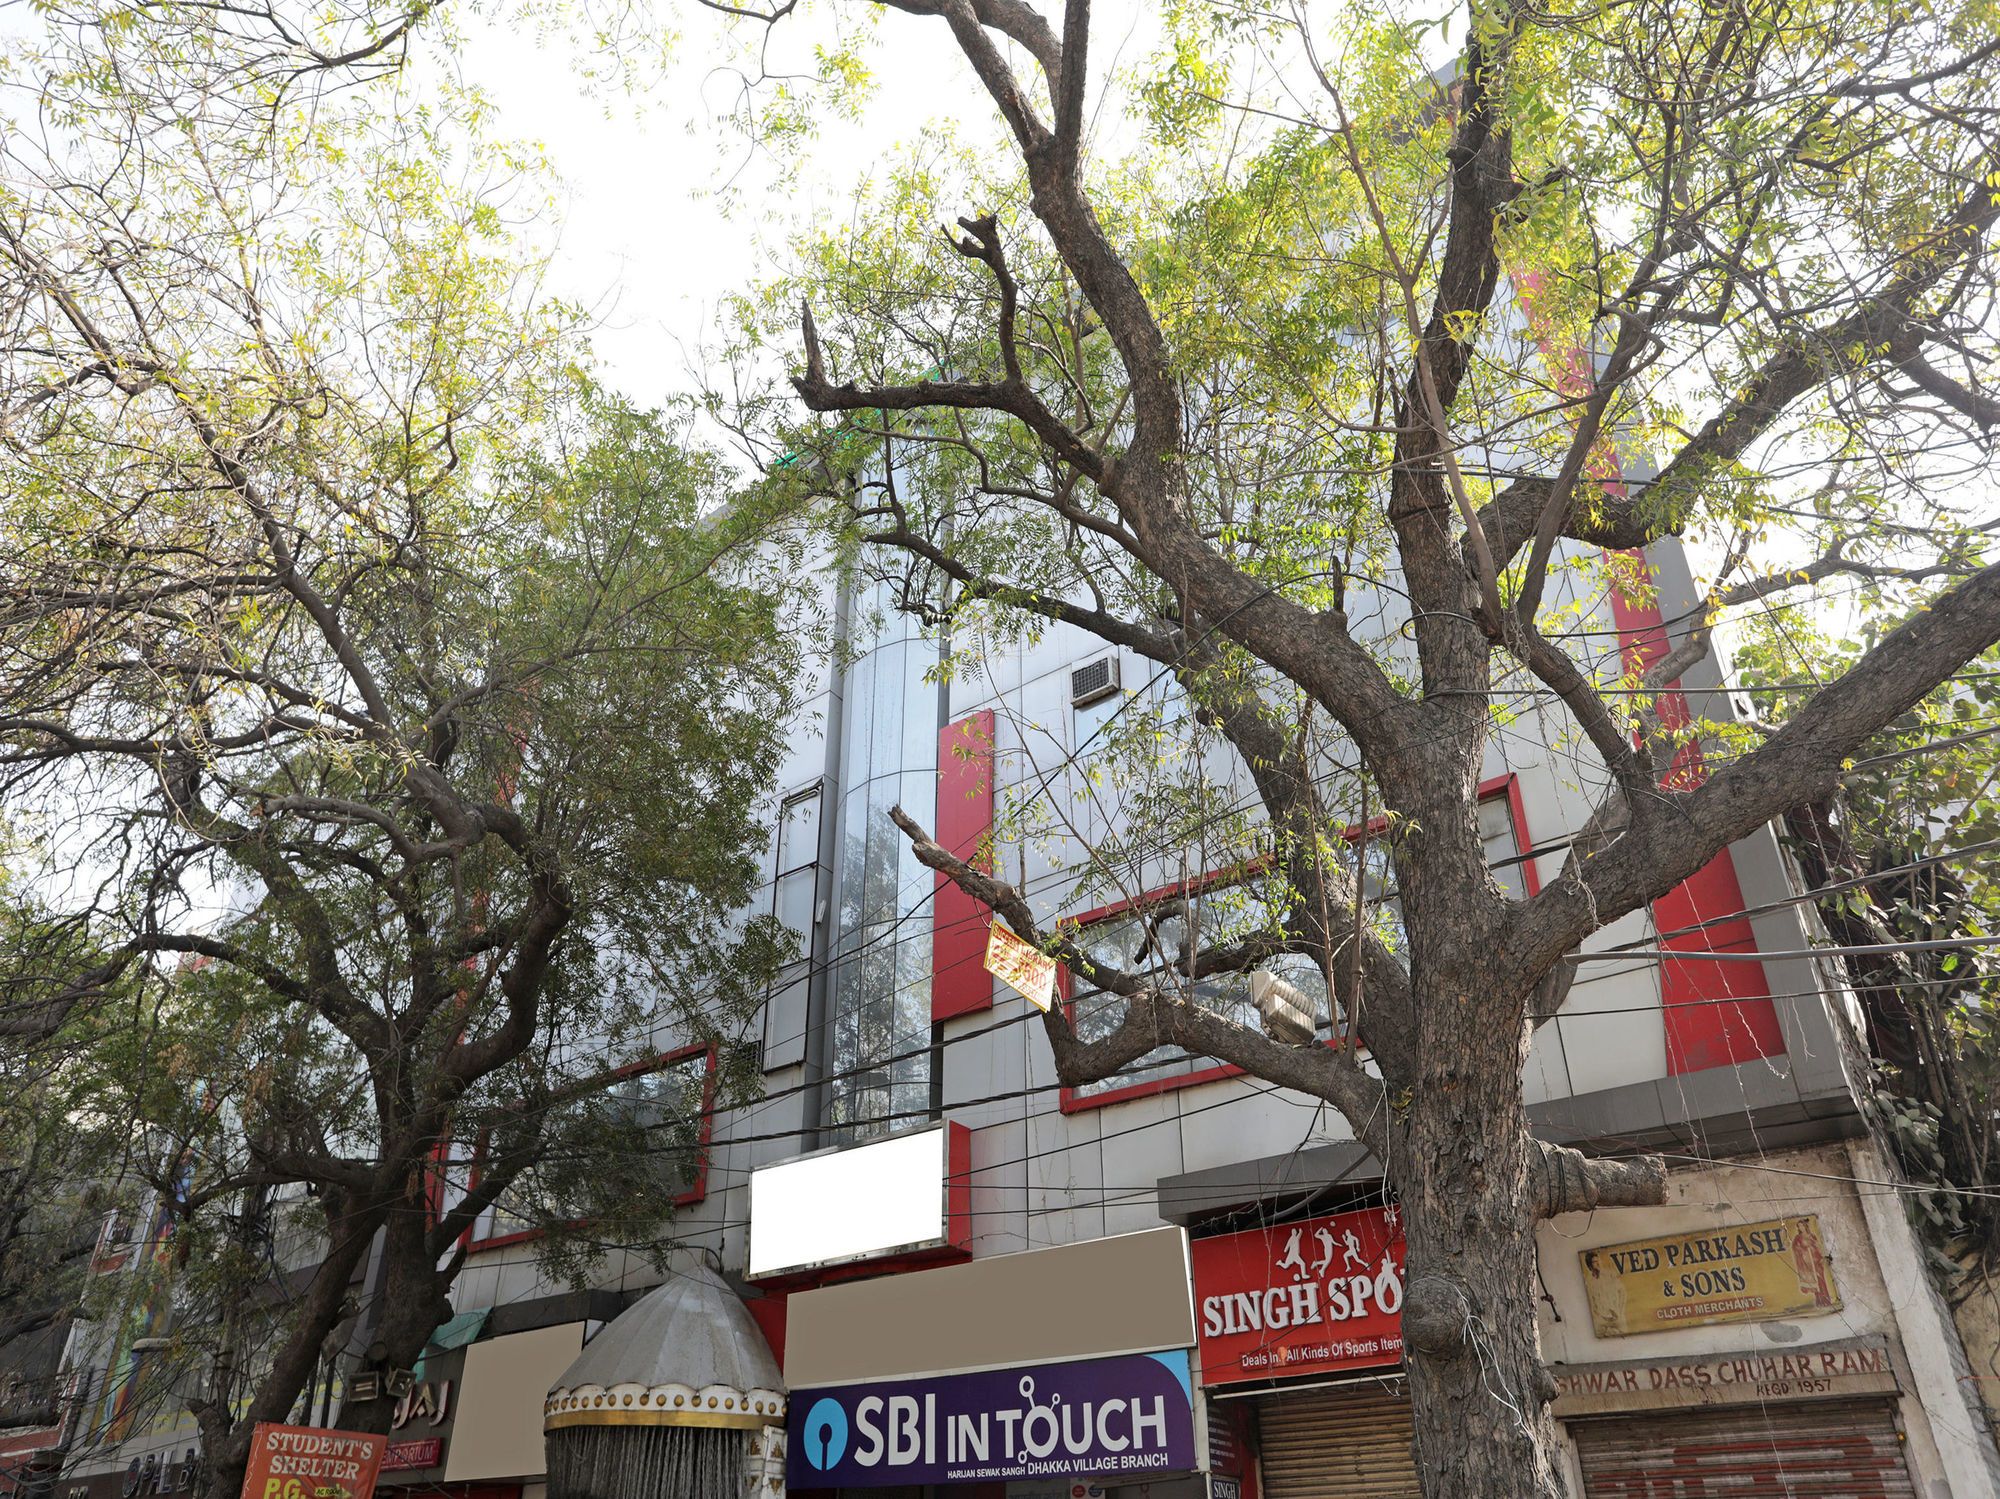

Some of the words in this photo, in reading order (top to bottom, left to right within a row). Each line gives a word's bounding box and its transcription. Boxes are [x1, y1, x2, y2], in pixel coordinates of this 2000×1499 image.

[1610, 1248, 1660, 1275] VED
[1663, 1228, 1786, 1267] PARKASH
[1663, 1281, 1676, 1297] &
[1680, 1266, 1746, 1298] SONS
[1203, 1282, 1323, 1338] SINGH
[1328, 1265, 1404, 1321] SPO
[1656, 1305, 1692, 1320] CLOTH
[1695, 1297, 1764, 1315] MERCHANTS
[1242, 1353, 1267, 1367] Deals
[1286, 1350, 1299, 1362] All
[1301, 1346, 1329, 1360] Kinds
[1331, 1343, 1343, 1356] Of
[1345, 1341, 1378, 1357] Sports
[1559, 1370, 1639, 1395] SHWAR
[1649, 1363, 1713, 1390] DASS
[1717, 1354, 1815, 1386] CHUHAR
[1820, 1349, 1881, 1376] RAM
[1798, 1378, 1832, 1394] 1957
[854, 1393, 936, 1467] SBI
[947, 1413, 990, 1463] IN
[996, 1391, 1168, 1464] TOUCH
[266, 1432, 374, 1460] STUDENT'S
[269, 1455, 360, 1481] SHELTER
[948, 1470, 976, 1479] HARIJAN
[976, 1468, 1000, 1478] SEWAK
[1002, 1467, 1026, 1477] SANGH
[1028, 1459, 1071, 1475] DHAKKA
[1073, 1457, 1118, 1472] VILLAGE
[1121, 1453, 1169, 1469] BRANCH
[1213, 1481, 1236, 1499] SINGH
